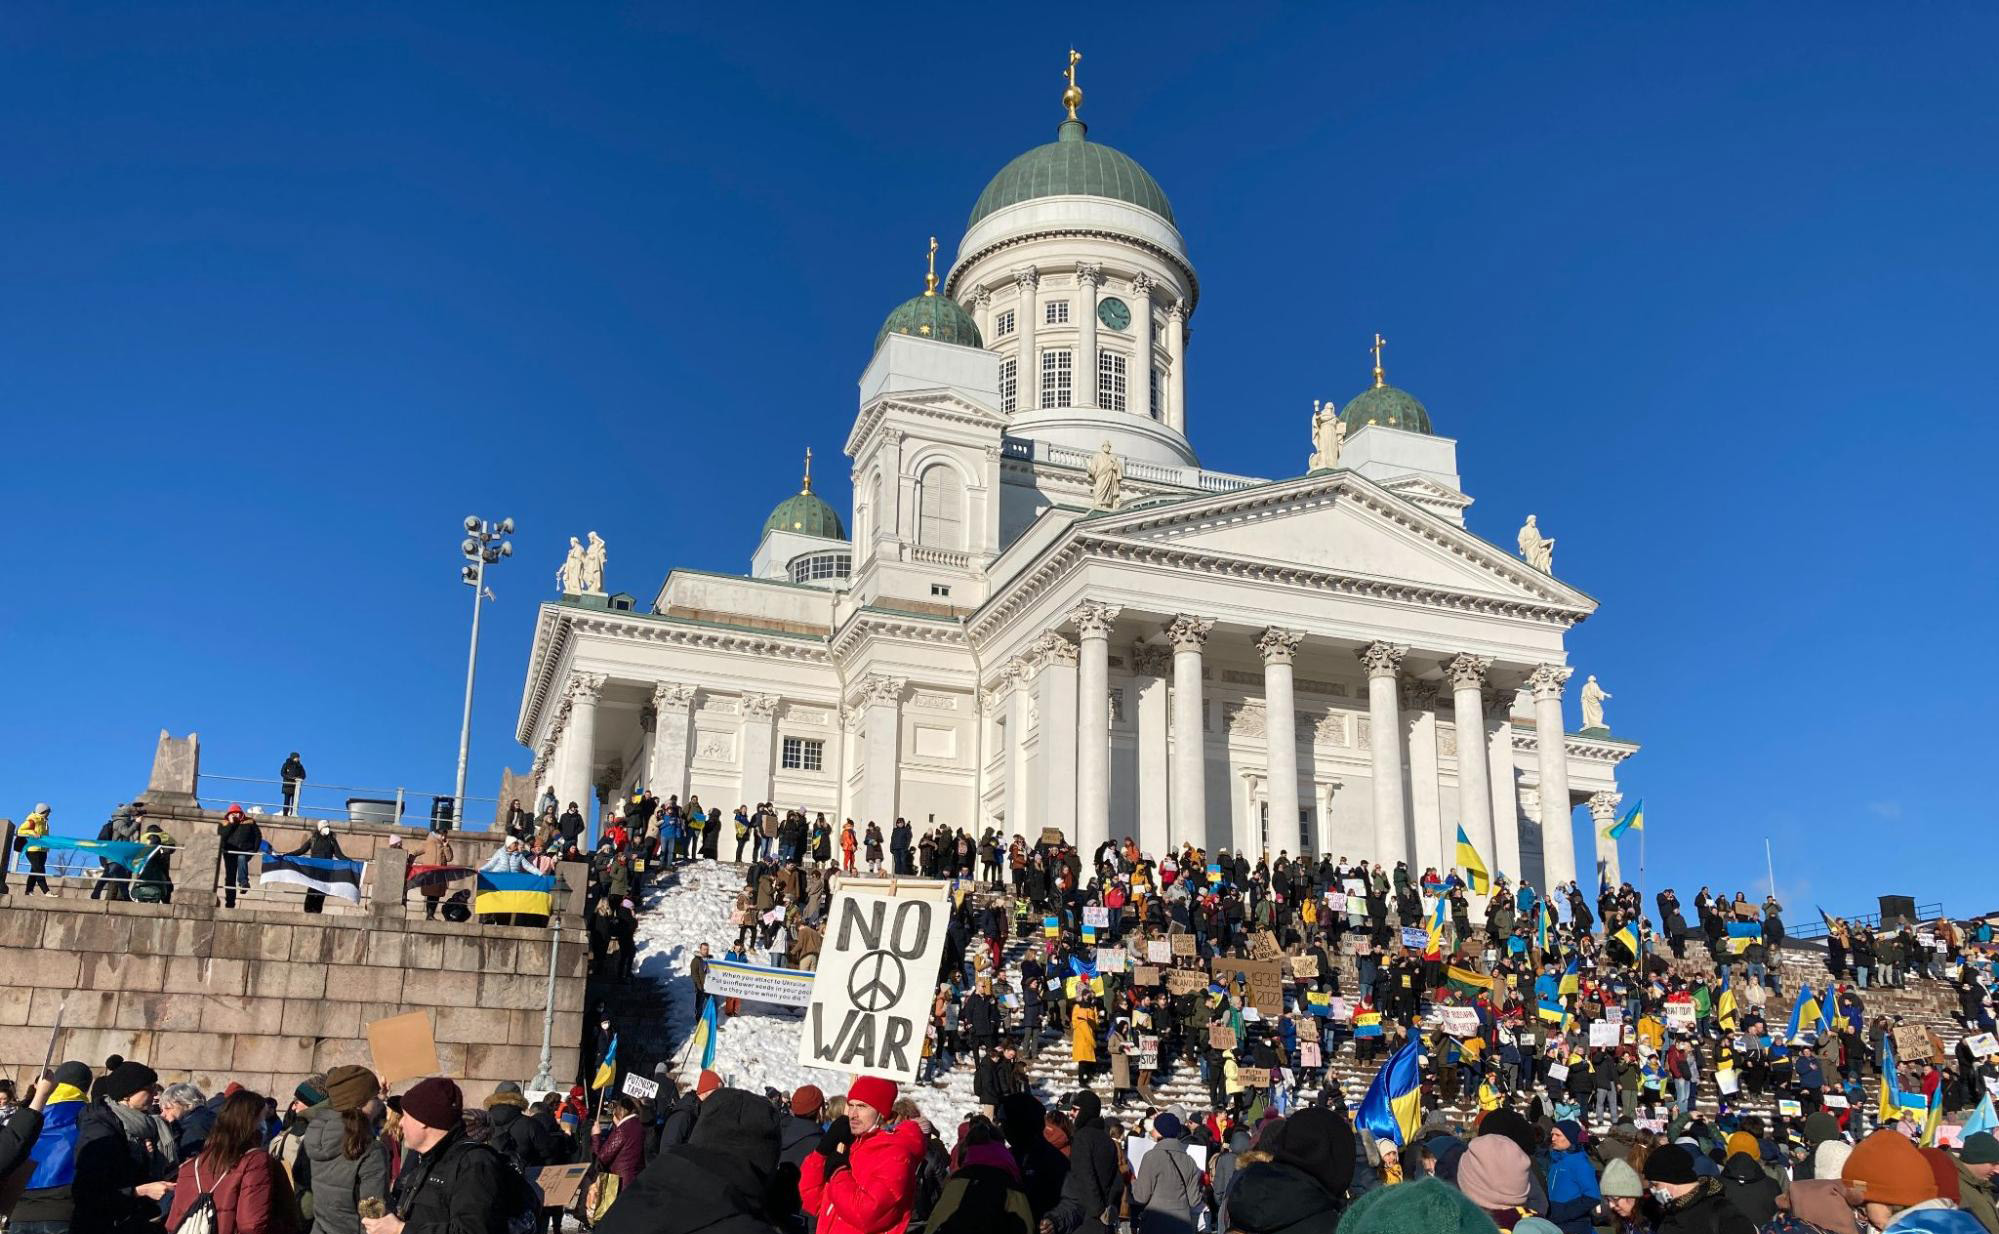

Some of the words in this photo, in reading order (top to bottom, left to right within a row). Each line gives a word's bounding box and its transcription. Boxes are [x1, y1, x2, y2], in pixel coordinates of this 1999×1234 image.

[836, 897, 932, 961] NO
[1251, 971, 1280, 988] 1939
[729, 986, 743, 994] they
[1256, 990, 1281, 1006] 2022
[812, 1002, 913, 1073] WAR
[1901, 1026, 1920, 1035] STOP
[1141, 1053, 1157, 1065] STOP
